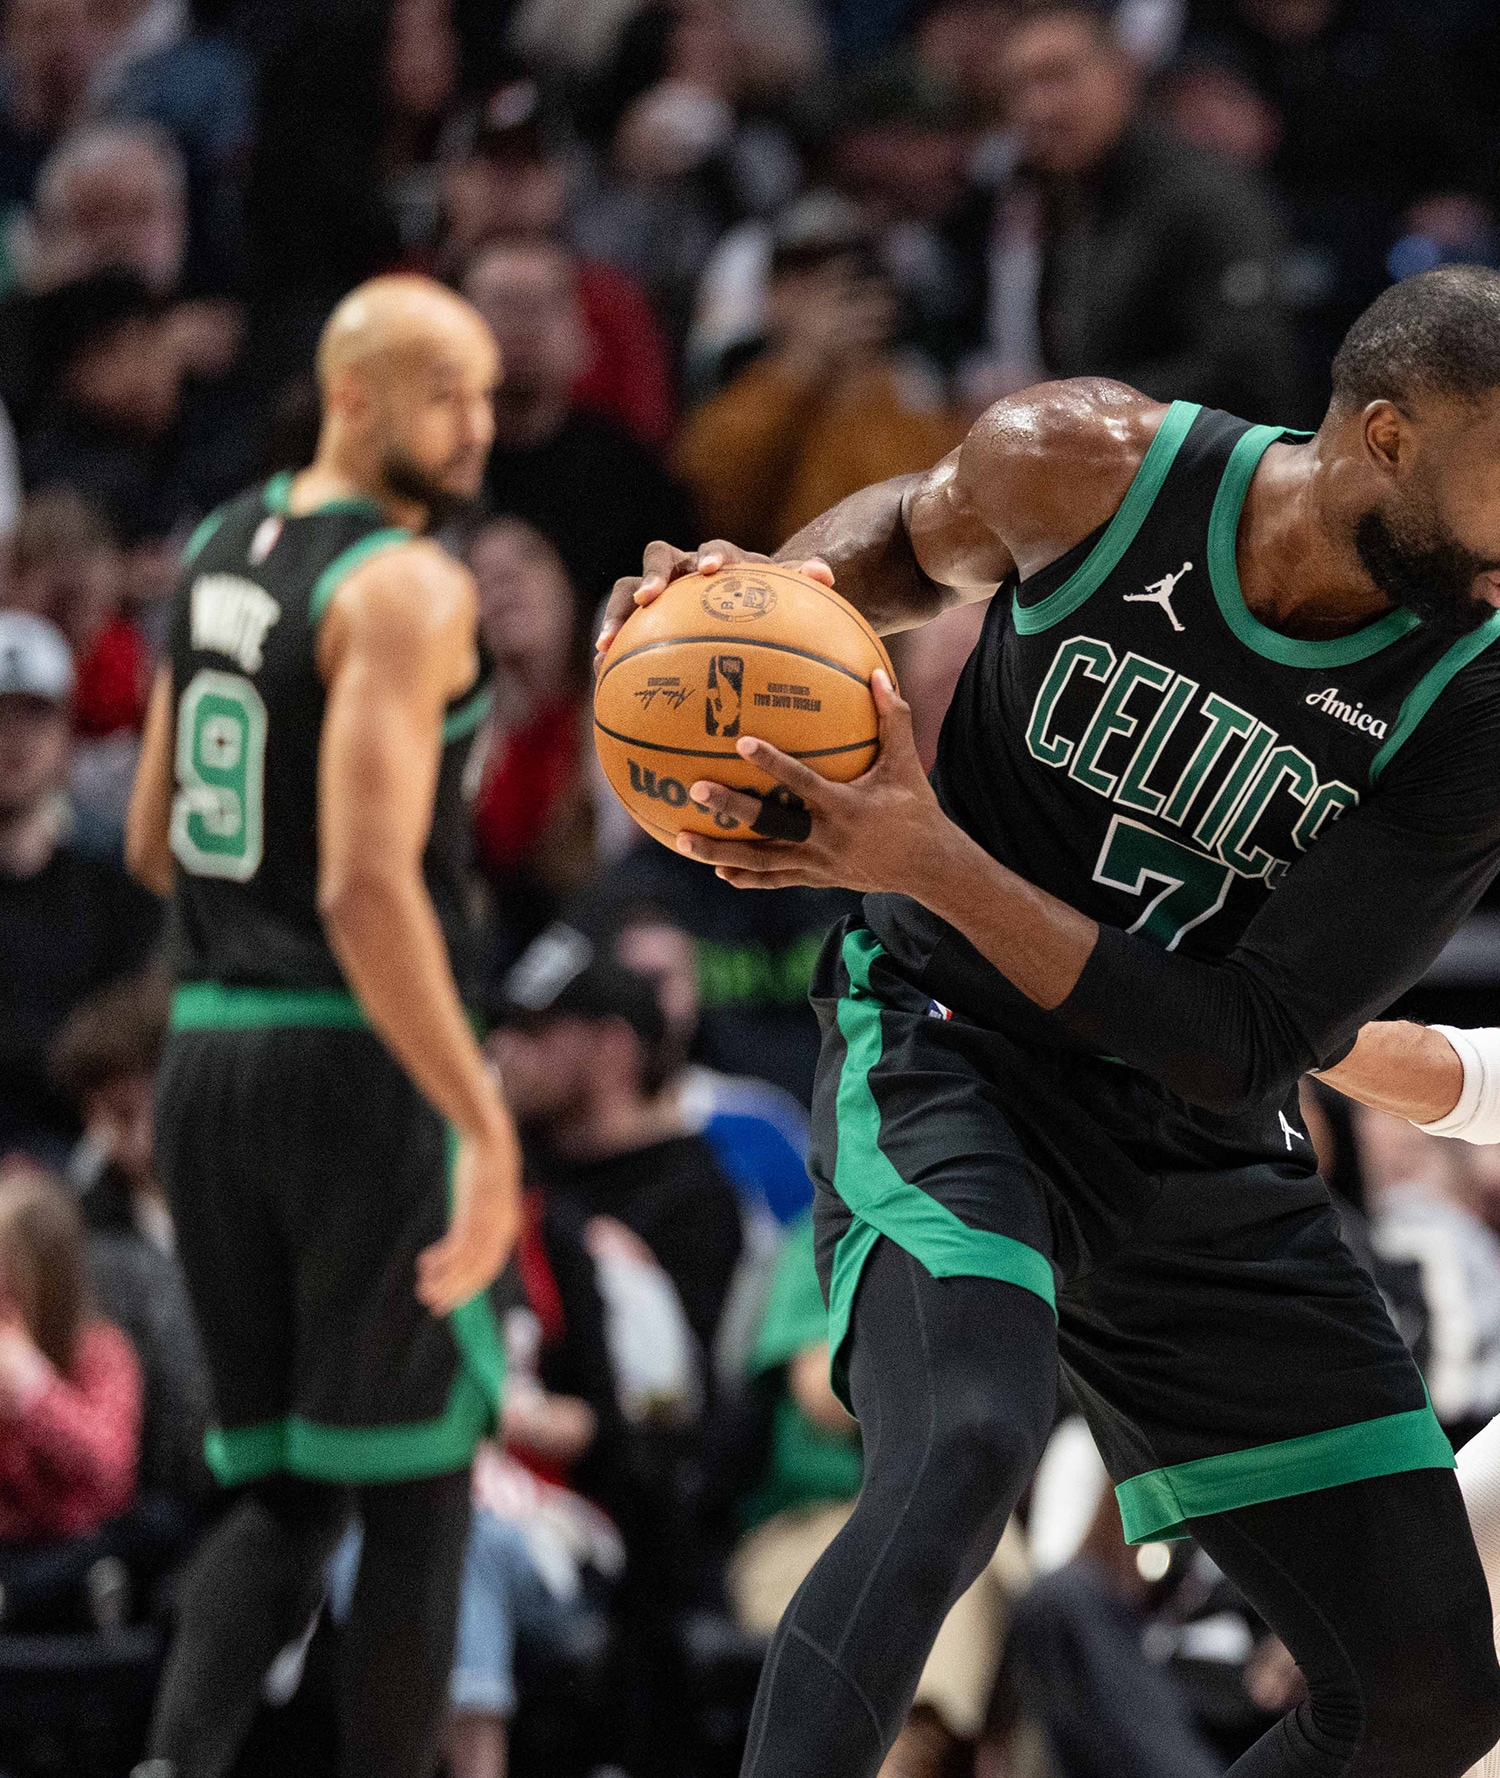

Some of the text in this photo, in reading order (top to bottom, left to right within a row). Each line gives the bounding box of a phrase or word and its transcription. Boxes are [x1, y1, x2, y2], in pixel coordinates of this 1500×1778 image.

[168, 668, 268, 884] 9
[1305, 687, 1388, 740] Amica
[1092, 814, 1236, 952] 7
